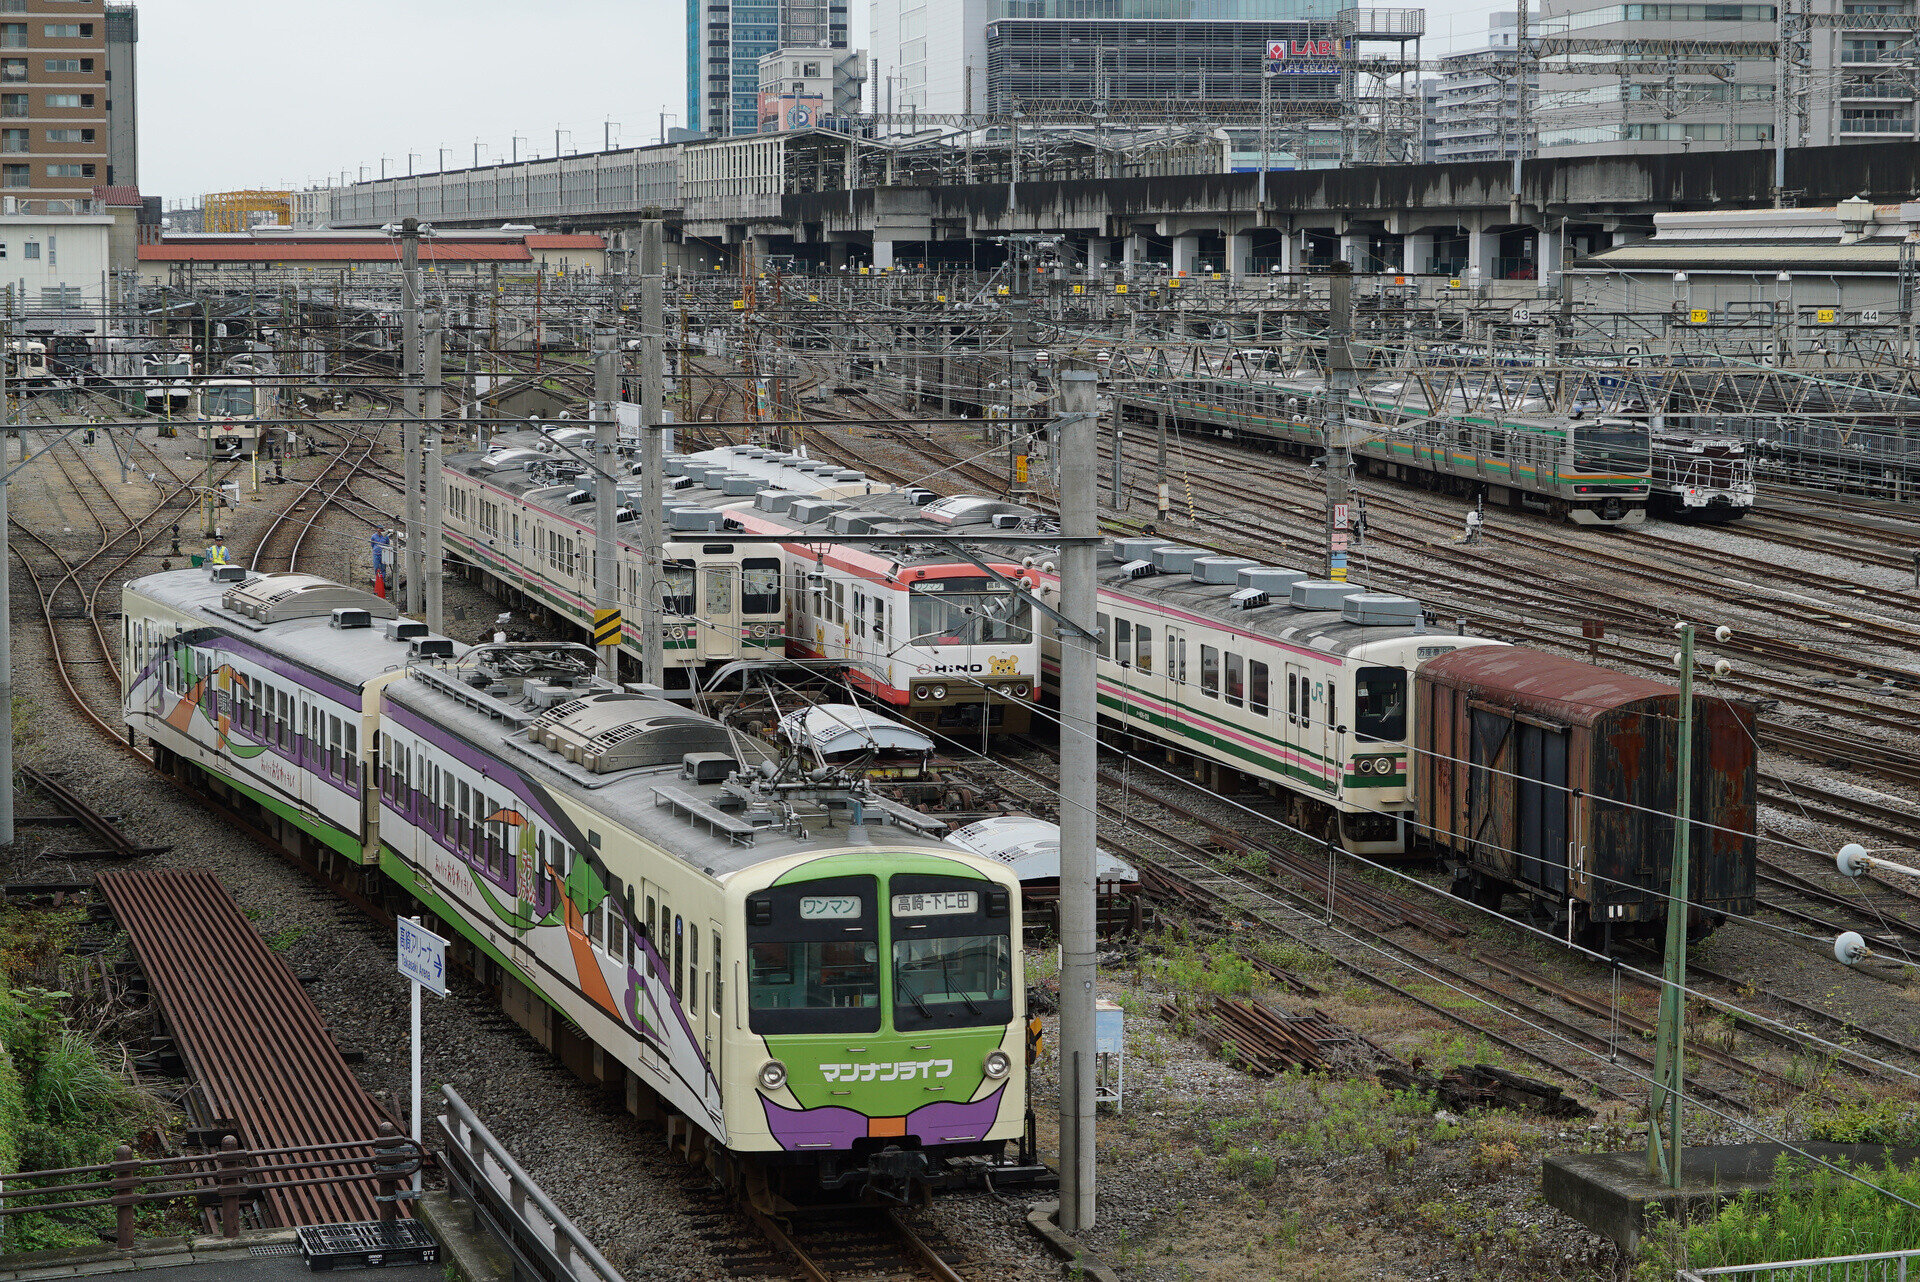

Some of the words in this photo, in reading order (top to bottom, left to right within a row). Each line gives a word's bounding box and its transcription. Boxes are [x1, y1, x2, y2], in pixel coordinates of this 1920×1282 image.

[1513, 310, 1529, 321] 43
[1691, 311, 1707, 321] 下り
[1818, 311, 1834, 321] 上り
[1863, 311, 1878, 321] 44
[1626, 346, 1640, 366] 2
[934, 664, 983, 673] HINO
[1311, 682, 1324, 704] JR
[803, 900, 855, 914] ワンマン
[898, 892, 969, 912] 高崎-下仁田
[400, 926, 433, 963] 高崎アリーナ
[819, 1059, 953, 1082] マンナンライフ
